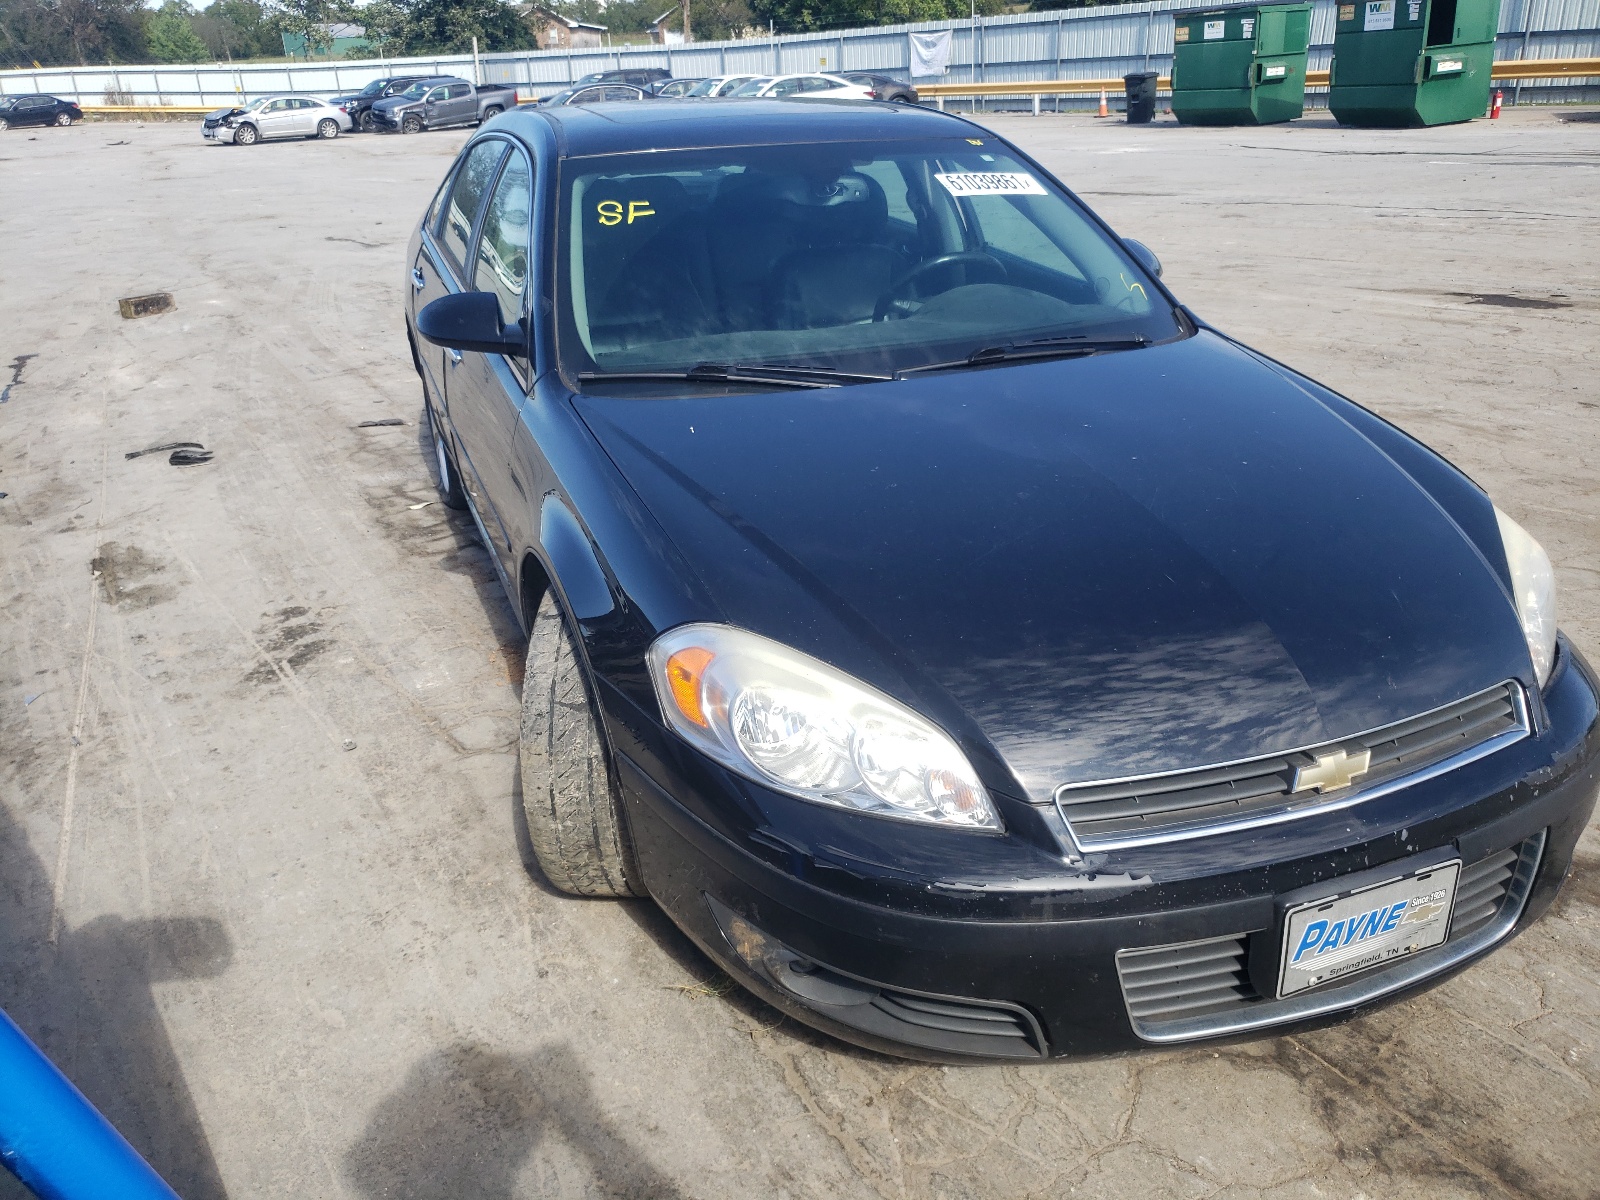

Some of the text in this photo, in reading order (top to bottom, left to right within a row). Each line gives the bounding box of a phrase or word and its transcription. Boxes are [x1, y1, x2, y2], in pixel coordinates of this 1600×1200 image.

[1369, 3, 1391, 13] WM
[945, 174, 1027, 191] 61039861
[597, 200, 656, 226] SF
[1411, 896, 1430, 907] Since
[1290, 899, 1410, 964] PAYNE
[1386, 947, 1400, 957] TN
